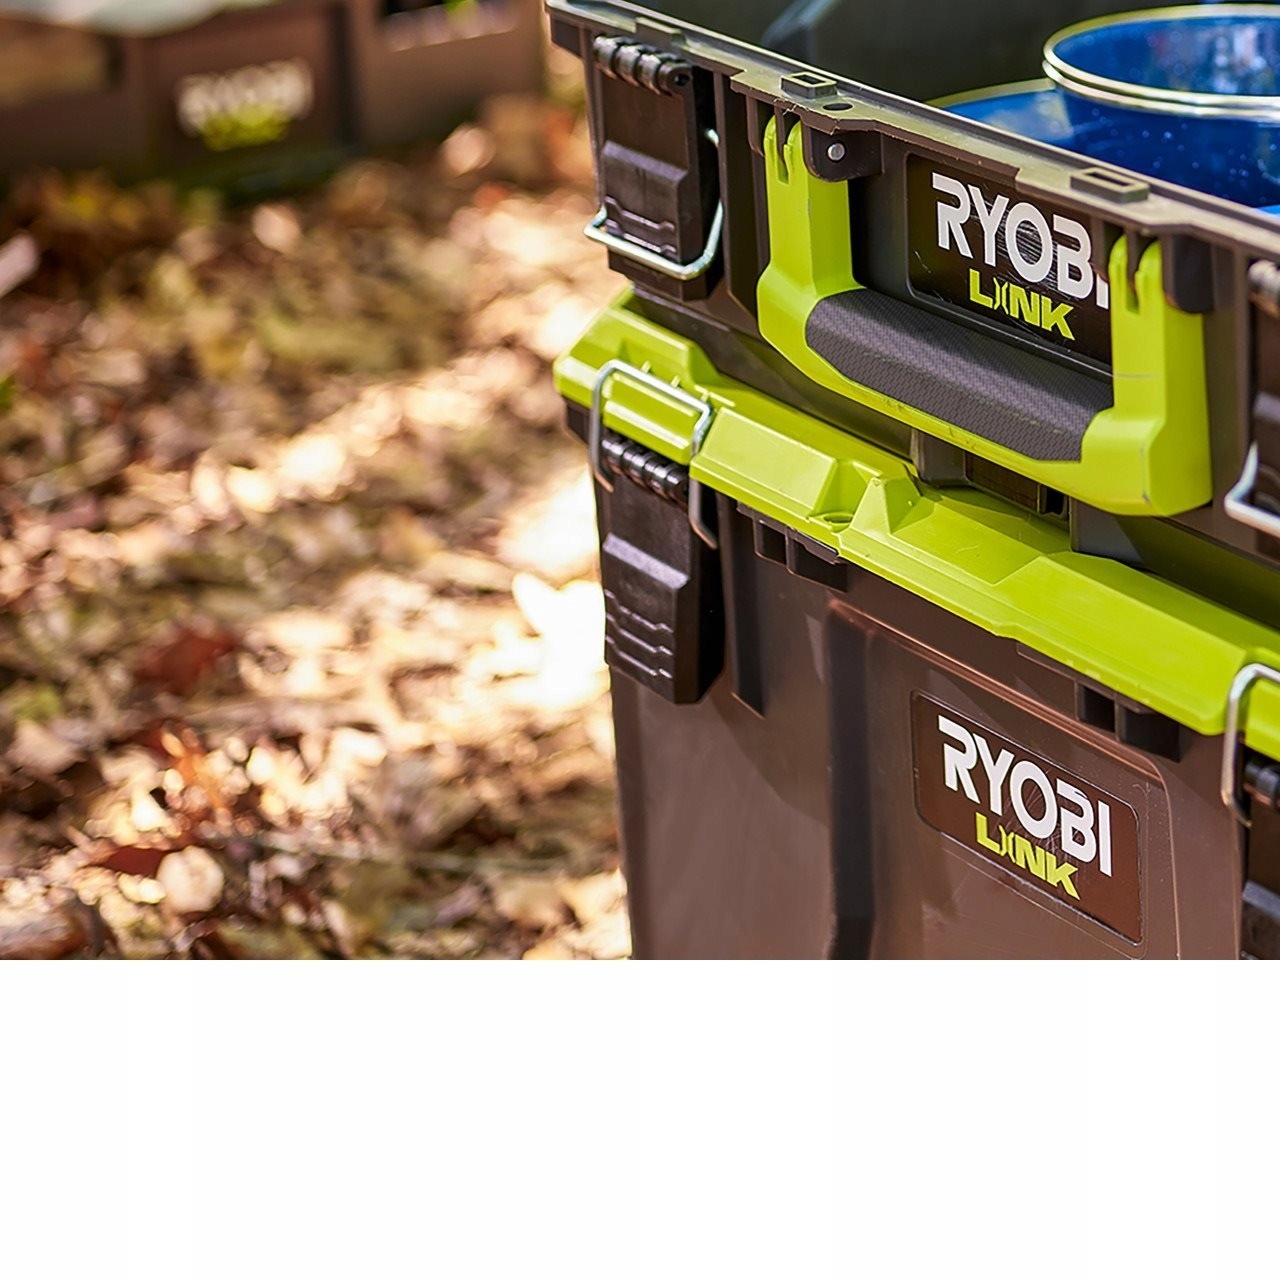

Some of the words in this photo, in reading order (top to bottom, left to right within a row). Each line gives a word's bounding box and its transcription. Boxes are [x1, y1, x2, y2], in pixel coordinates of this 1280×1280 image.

[969, 269, 1076, 340] LINK
[939, 715, 1112, 877] RYOBI
[976, 812, 1080, 900] LINK
